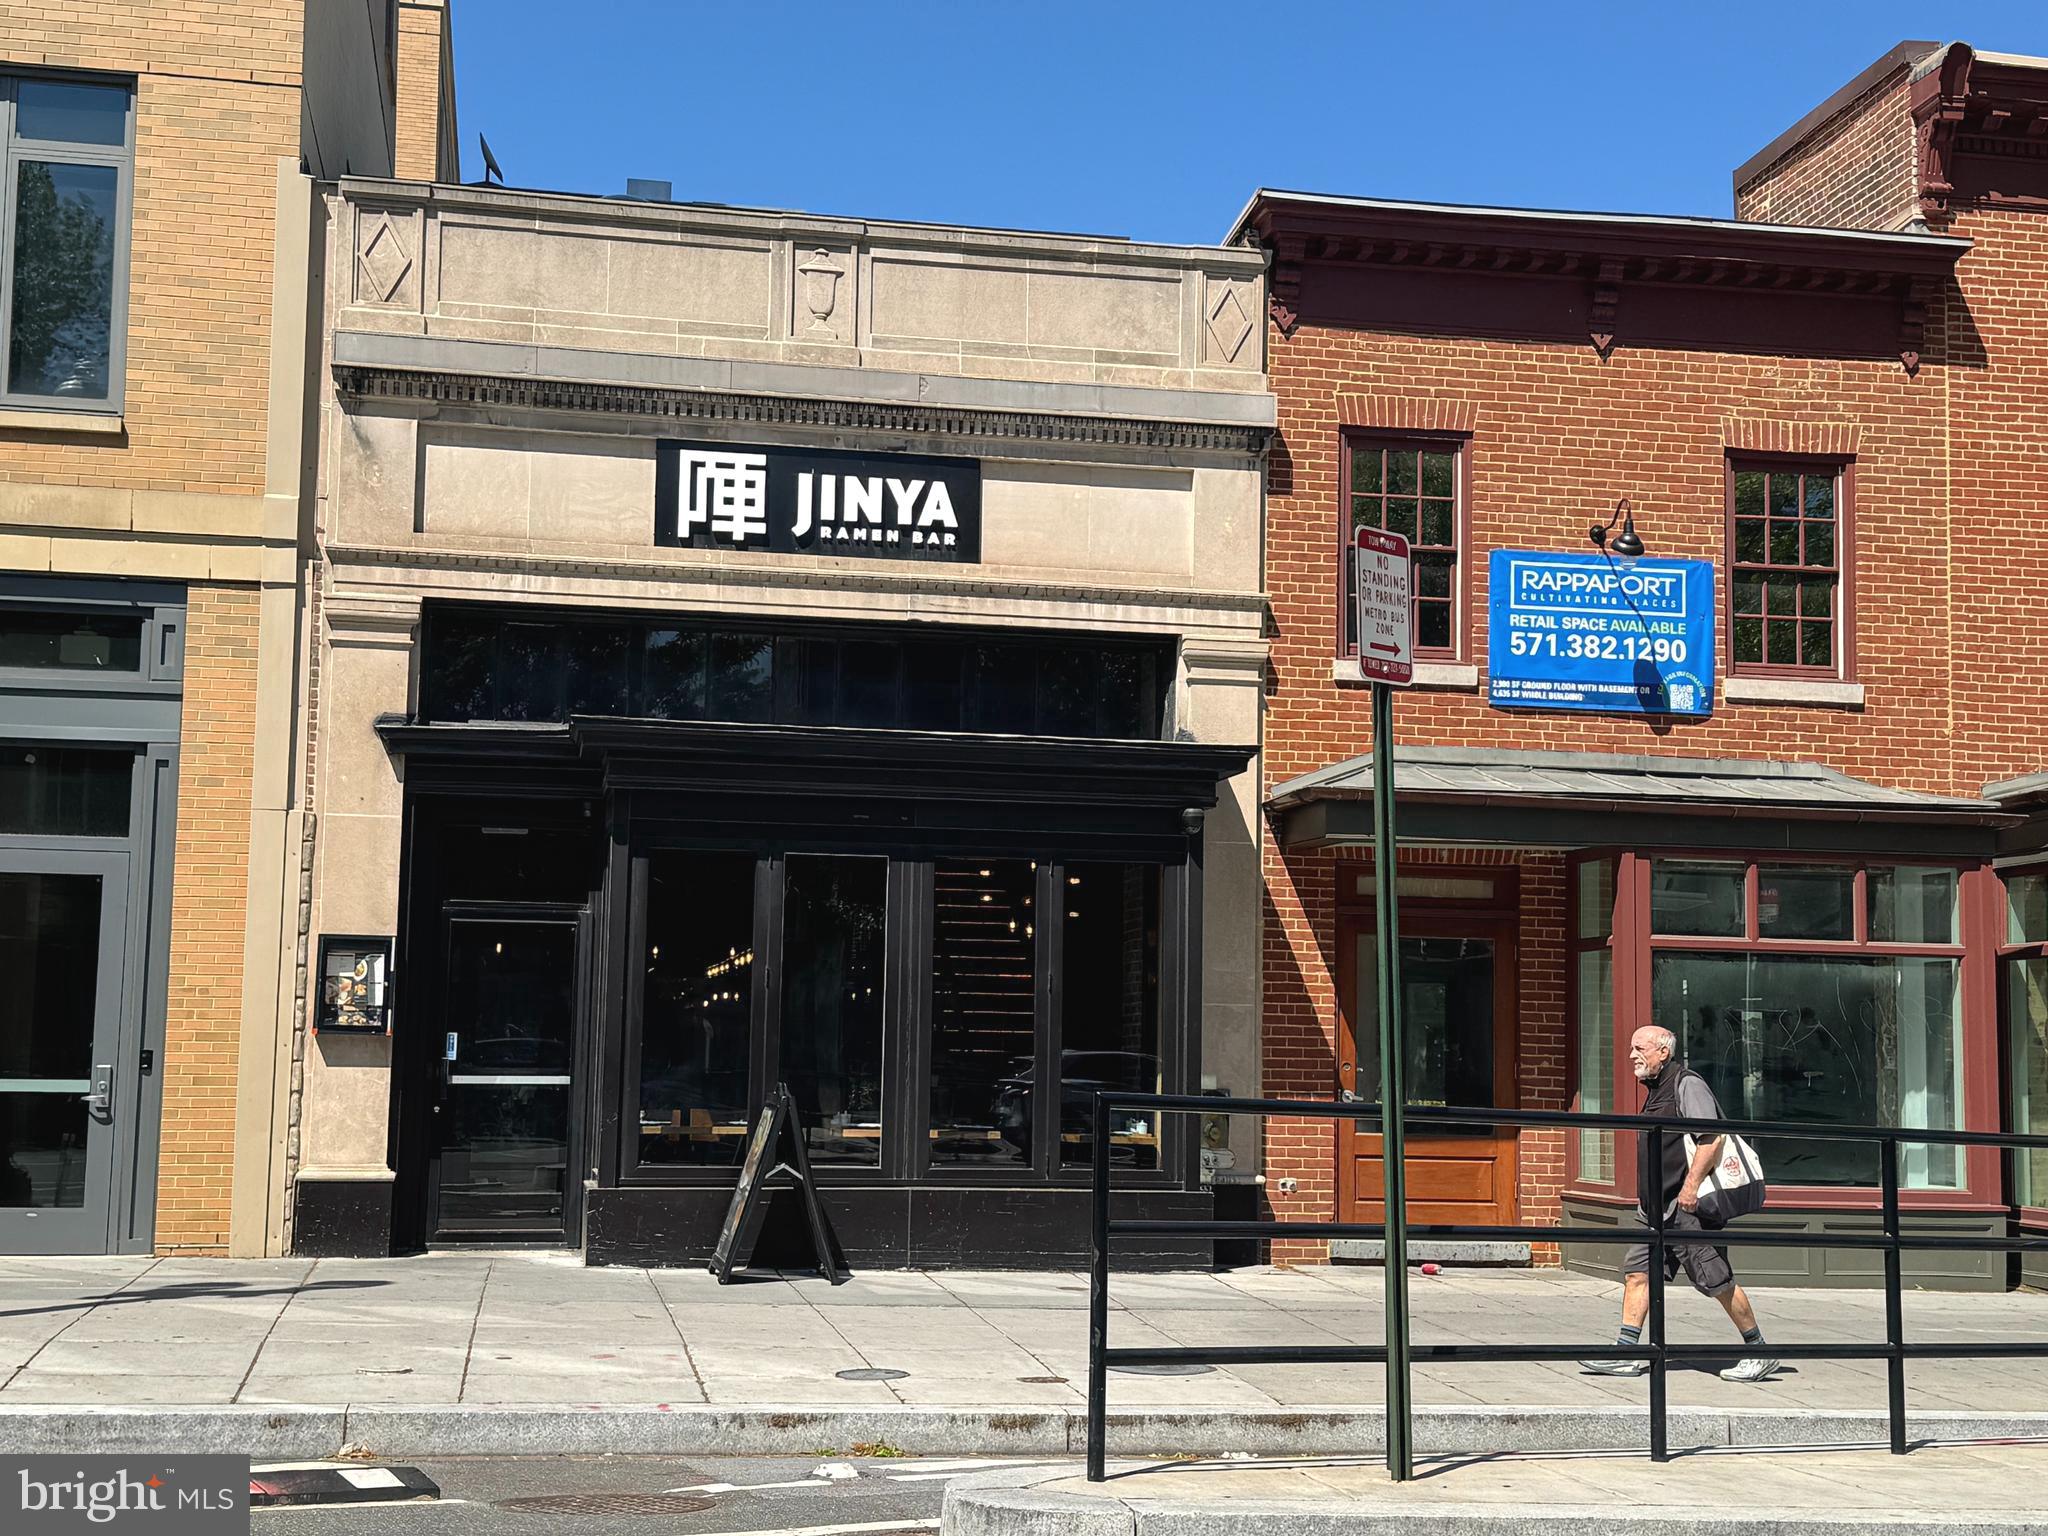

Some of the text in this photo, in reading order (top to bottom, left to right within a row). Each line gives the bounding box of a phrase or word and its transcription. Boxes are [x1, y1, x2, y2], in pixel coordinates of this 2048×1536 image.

[791, 472, 959, 537] JINYA
[820, 526, 957, 546] RAMEN BAR
[1377, 554, 1389, 570] NO
[1362, 569, 1406, 591] STANDING
[1521, 570, 1677, 597] RAPPAPORT
[1362, 586, 1407, 608] OR PARKING
[1521, 592, 1617, 605] CULTIVATING
[1365, 606, 1405, 624] METRO BUS
[1510, 614, 1559, 629] RETAIL
[1562, 616, 1608, 632] SPACE
[1376, 622, 1394, 637] ZONE
[1510, 631, 1687, 663] 571.382.1290
[1511, 680, 1520, 689] SF
[1521, 681, 1553, 690] GROUND
[1553, 682, 1576, 692] FLOOR
[1577, 684, 1598, 693] WITH
[1598, 684, 1638, 694] BASEMENT
[1640, 686, 1650, 695] OR
[1511, 689, 1520, 698] SF
[1520, 690, 1548, 700] WHOLE
[1548, 691, 1584, 702] BUILDING
